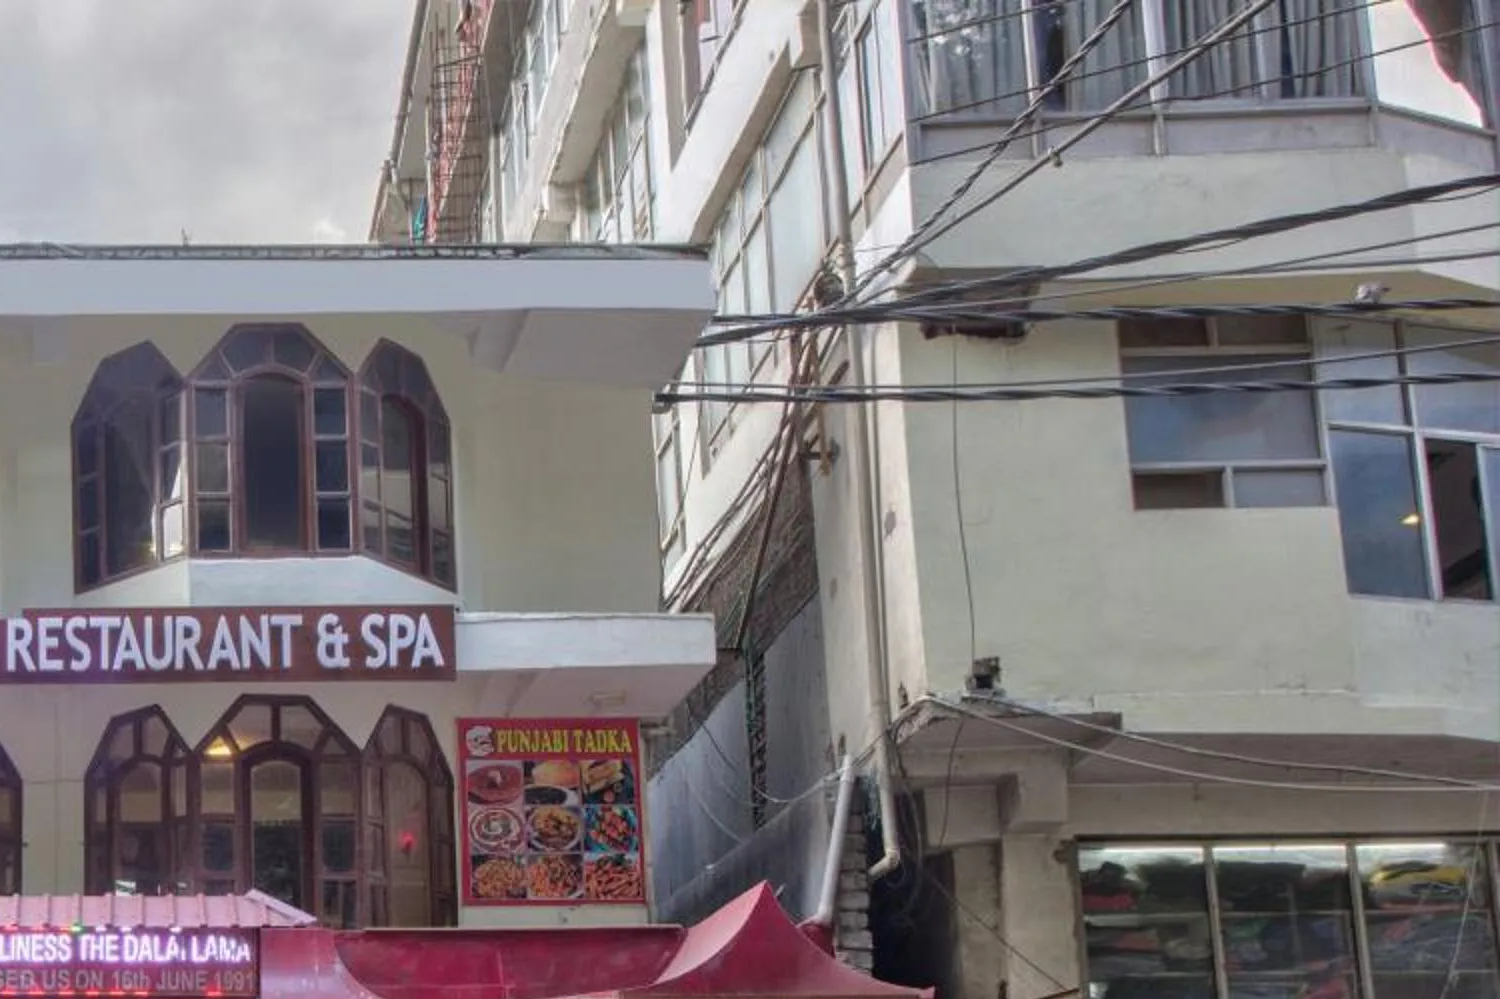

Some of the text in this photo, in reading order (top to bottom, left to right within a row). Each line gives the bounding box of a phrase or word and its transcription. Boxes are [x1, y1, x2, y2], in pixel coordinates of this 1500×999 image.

[5, 614, 303, 673] RESTAURANT
[316, 613, 350, 669] &
[361, 613, 444, 669] SPA
[495, 728, 632, 753] PUNJABI TADKA
[79, 933, 119, 962] THE
[192, 933, 251, 962] LAMA
[41, 969, 70, 990] US
[75, 970, 103, 990] ON
[112, 970, 150, 990] 16th
[156, 970, 208, 991] JUNE
[214, 970, 256, 991] 1991
